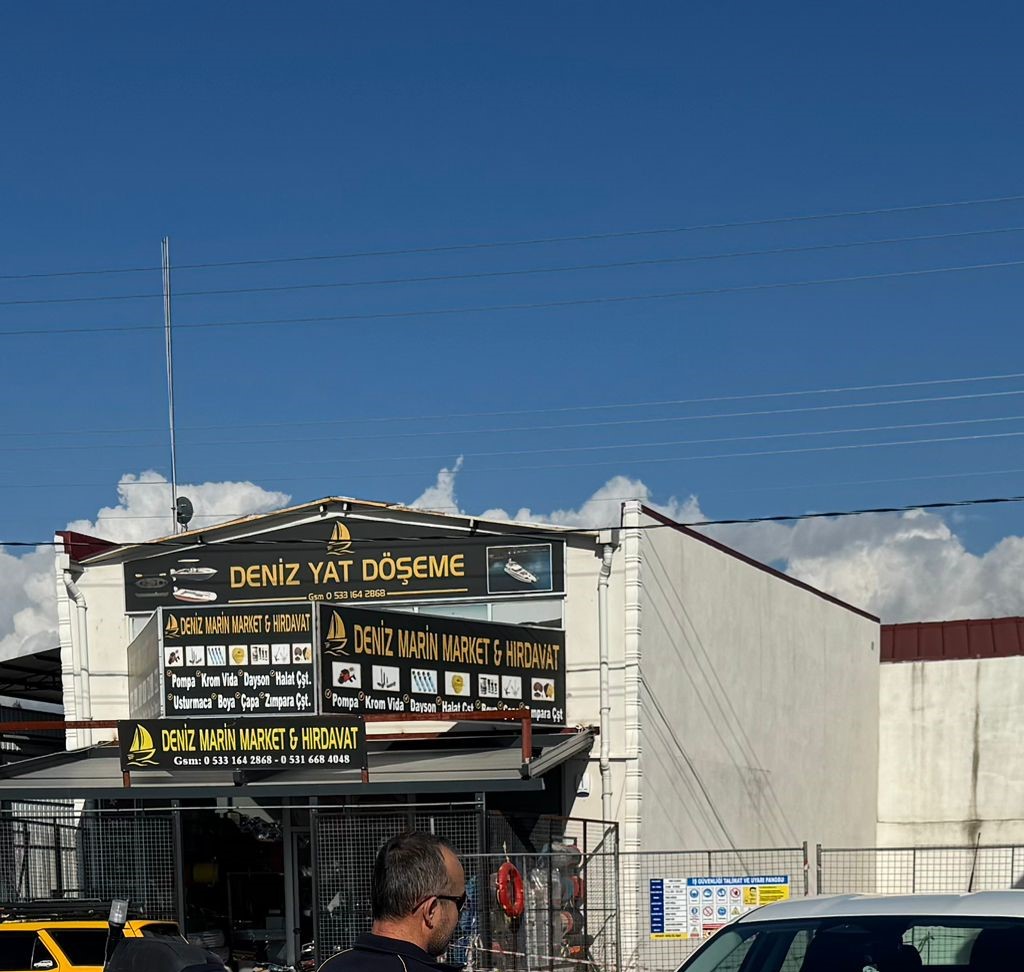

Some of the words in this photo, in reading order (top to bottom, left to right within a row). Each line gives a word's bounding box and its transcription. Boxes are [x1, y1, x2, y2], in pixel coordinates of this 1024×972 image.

[230, 558, 300, 588] DENİZ
[308, 560, 353, 584] YAT
[362, 552, 465, 585] DÖŞEME
[308, 592, 324, 601] Gsm
[326, 592, 332, 600] 0
[334, 591, 347, 599] 533
[350, 590, 362, 599] 164
[365, 589, 386, 598] 2868
[180, 612, 203, 635] DENİZ
[205, 611, 229, 634] MARİN
[232, 615, 262, 633] MARKET
[265, 614, 270, 632] &
[273, 613, 310, 632] HIRDAVAT
[353, 620, 394, 657] DENİZ
[398, 625, 438, 661] MARİN
[442, 635, 490, 665] MARKET
[493, 640, 502, 666] &
[506, 640, 560, 671] HIRDAVAT
[172, 673, 195, 691] Pompa
[201, 673, 220, 688] Krom
[221, 672, 238, 686] Vida
[243, 672, 270, 689] Dayson
[275, 671, 295, 686] Halat
[173, 695, 212, 710] Usturmaca
[218, 694, 235, 711] Boya
[241, 693, 259, 711] Çapa
[265, 693, 294, 710] Zımpara
[332, 693, 359, 711] Pompa
[365, 695, 385, 710] Krom
[387, 696, 404, 711] Vida
[410, 699, 436, 713] Dayson
[442, 701, 460, 712] Halat
[161, 723, 196, 752] DENİZ
[199, 723, 236, 751] MARİN
[240, 728, 285, 750] MARKET
[290, 728, 298, 750] &
[302, 727, 358, 749] HIRDAVAT
[173, 756, 201, 767] Gsm:
[204, 756, 210, 765] 0
[212, 756, 228, 765] 533
[231, 756, 247, 764] 164
[250, 756, 272, 764] 2868
[281, 755, 286, 764] 0
[288, 755, 305, 763] 531
[308, 754, 325, 763] 668
[327, 754, 350, 763] 4048
